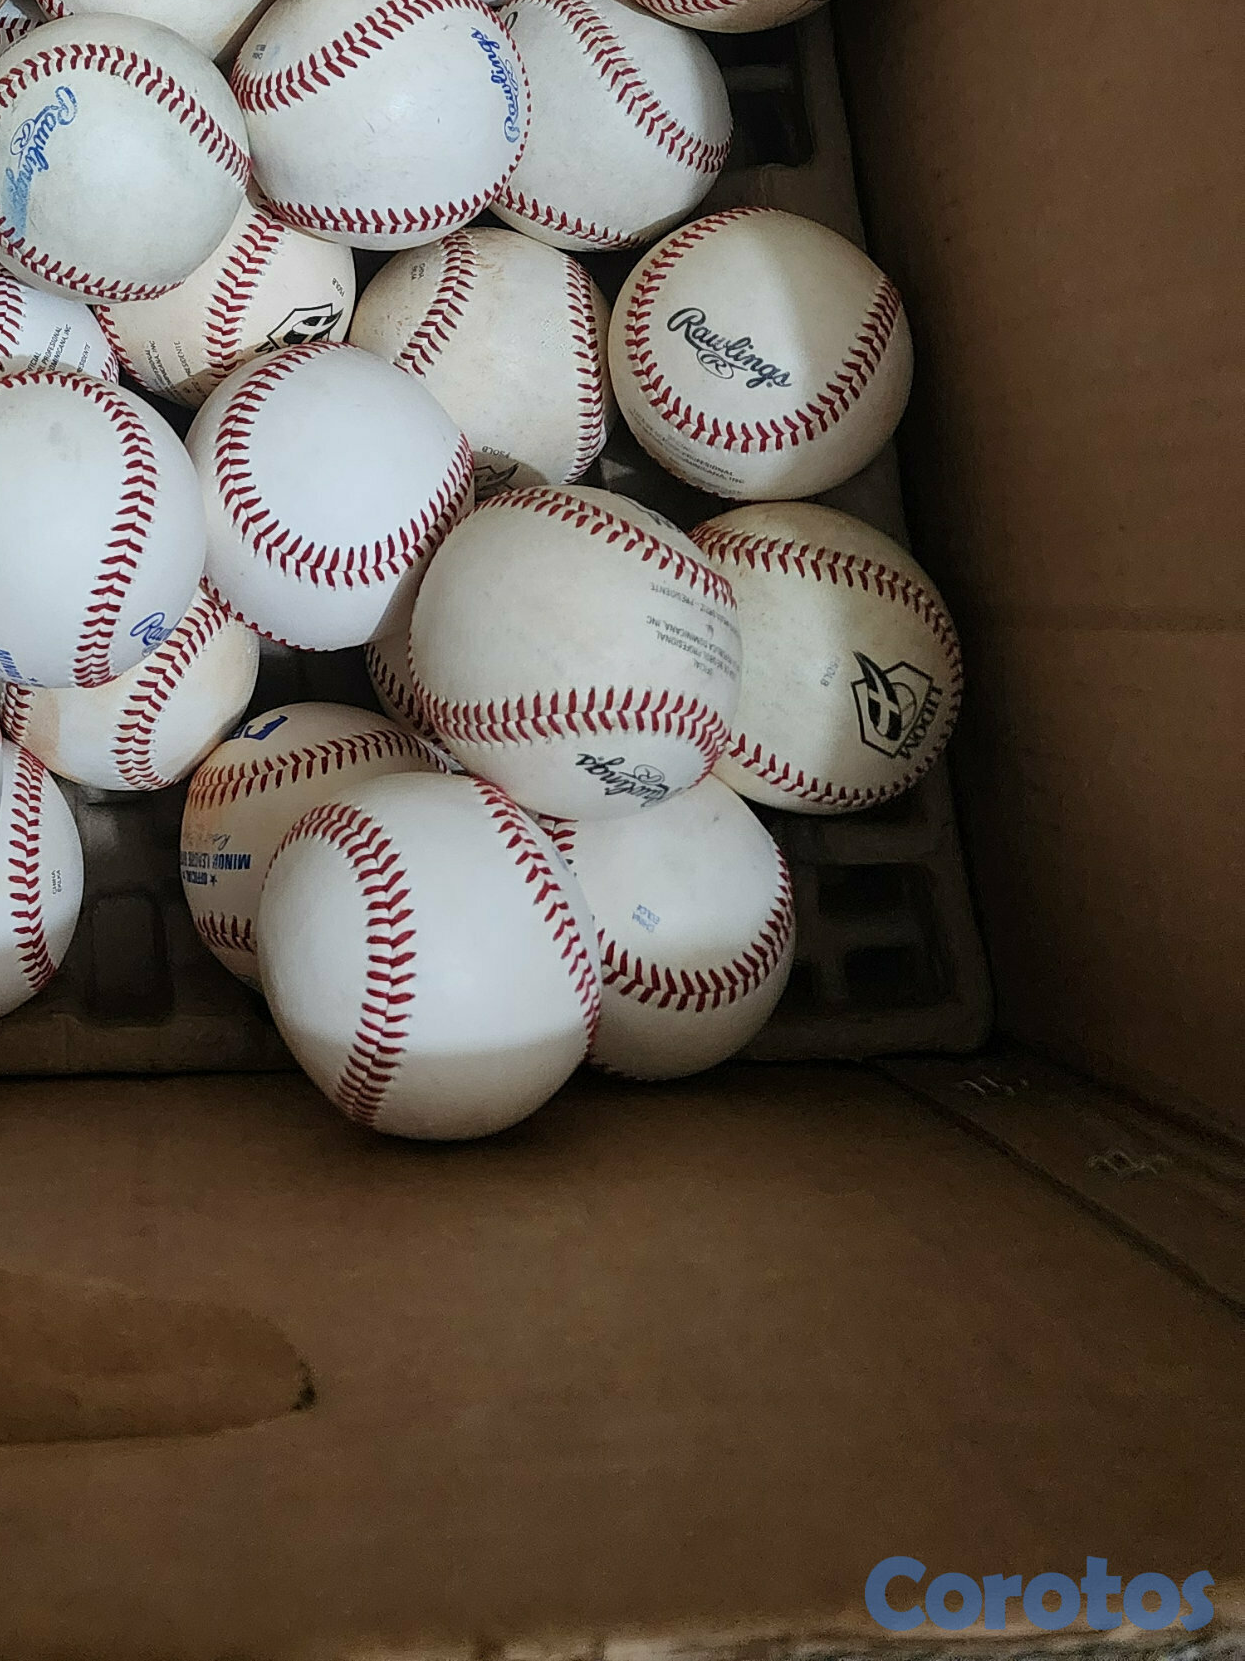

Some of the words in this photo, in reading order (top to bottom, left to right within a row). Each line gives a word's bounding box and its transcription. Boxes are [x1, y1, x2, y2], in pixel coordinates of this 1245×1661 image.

[471, 26, 520, 143] Rawlings
[27, 351, 42, 372] FICIAL
[42, 326, 63, 370] PROFESIONAL
[666, 307, 792, 389] Rawlings
[212, 853, 252, 870] MINOR
